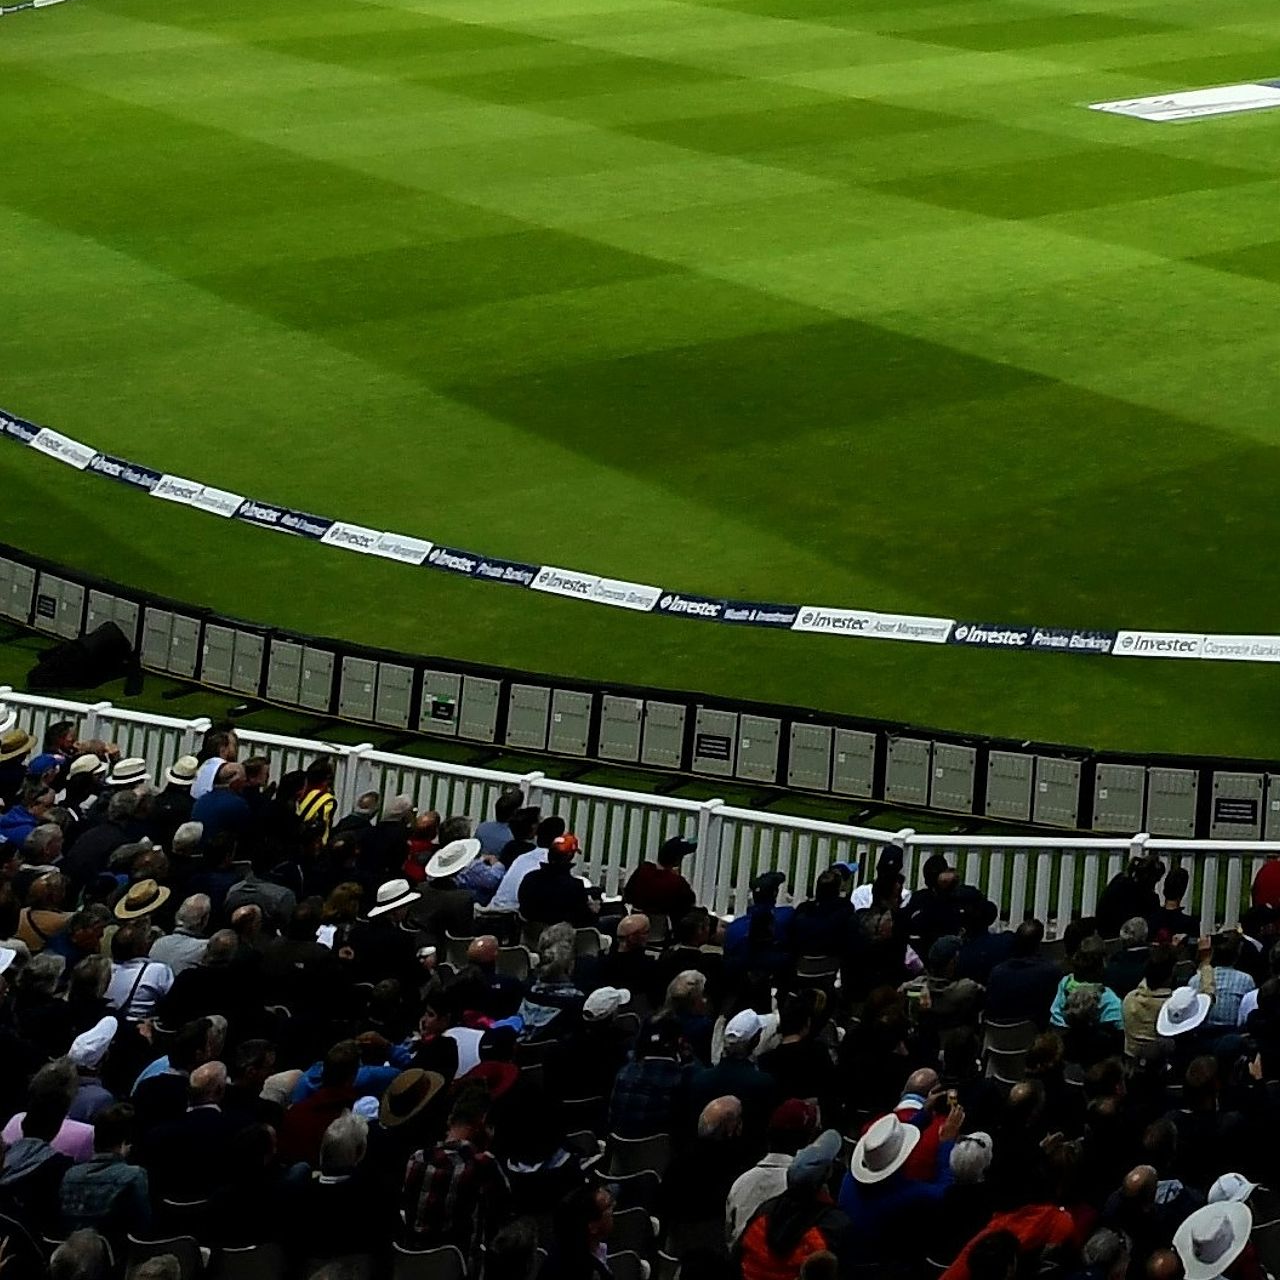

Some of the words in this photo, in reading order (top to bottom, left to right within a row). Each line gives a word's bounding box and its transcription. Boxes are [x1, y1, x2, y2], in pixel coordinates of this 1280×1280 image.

[435, 549, 477, 573] Investec
[547, 570, 593, 594] Investec
[671, 595, 722, 616] Investec
[812, 612, 870, 631] Investec
[966, 627, 1028, 646] Investec
[1031, 630, 1067, 647] Private
[1069, 633, 1112, 652] Banking
[1134, 636, 1198, 653] Investec
[1203, 641, 1249, 657] Corporate
